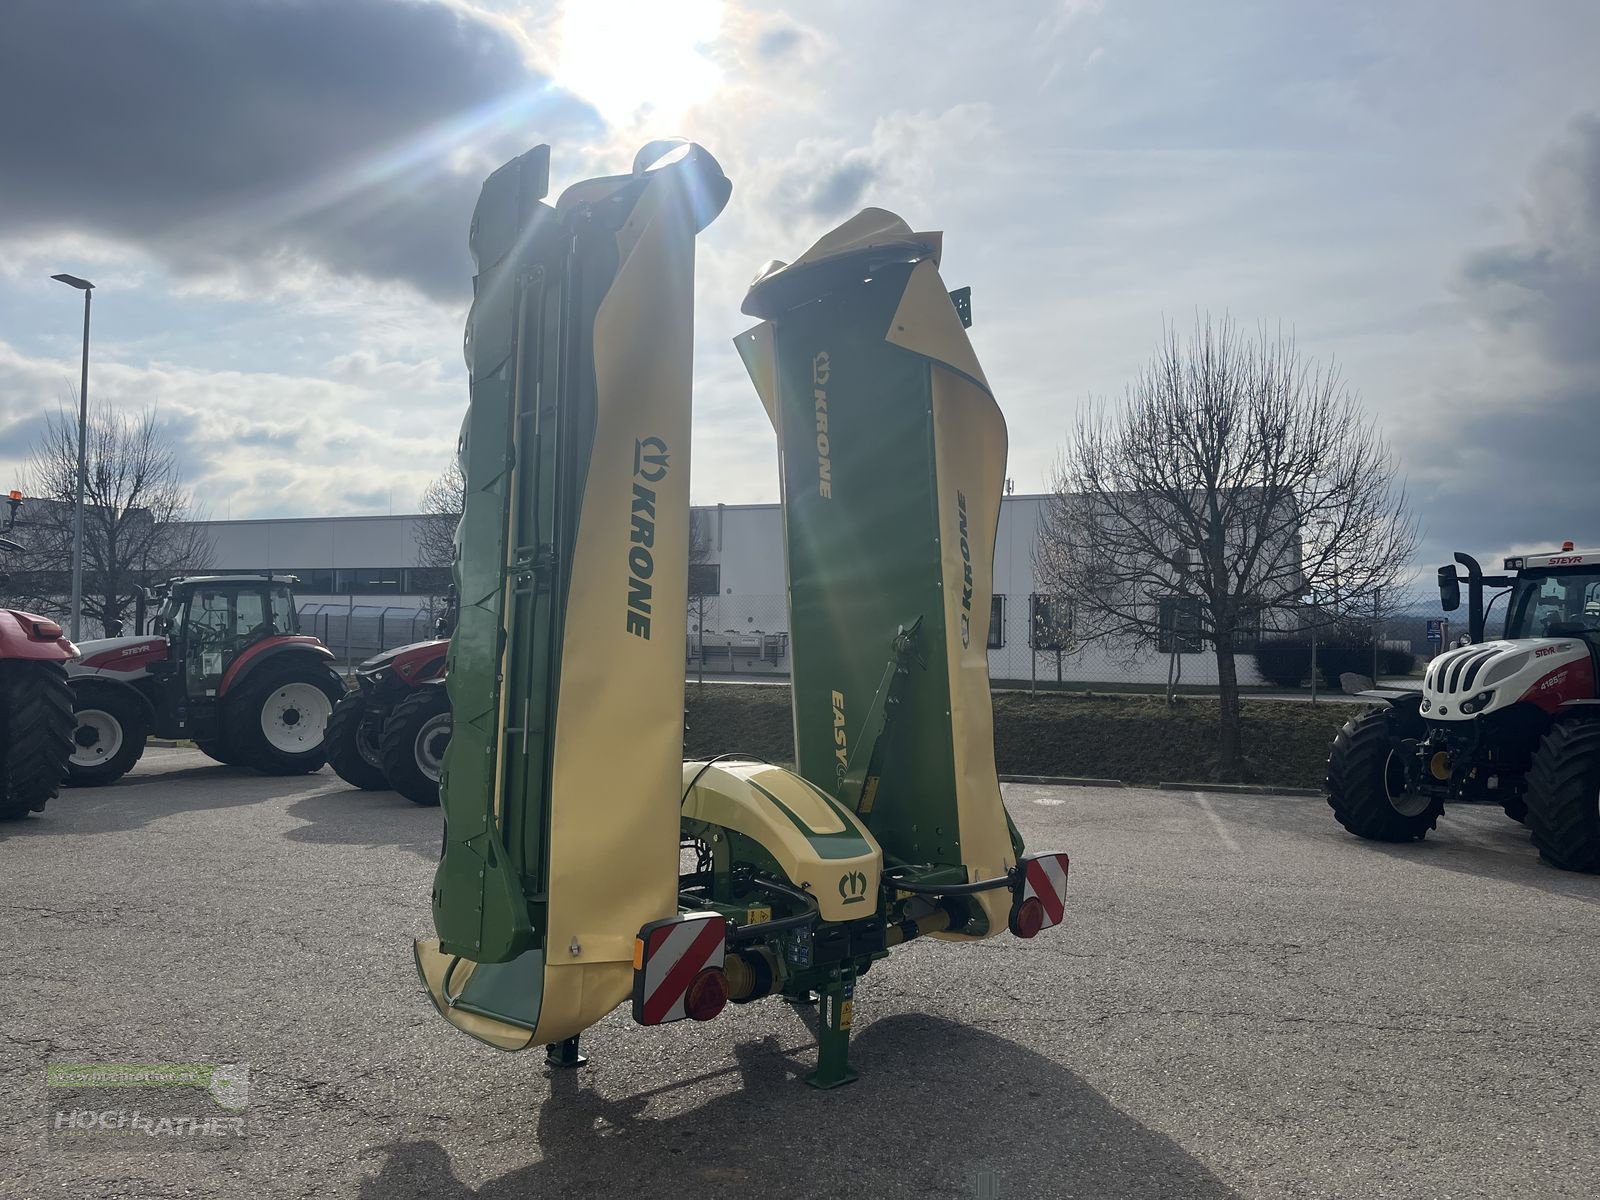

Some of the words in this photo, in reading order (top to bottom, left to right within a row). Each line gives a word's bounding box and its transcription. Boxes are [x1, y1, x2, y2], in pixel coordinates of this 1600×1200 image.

[814, 389, 832, 499] KRONE
[626, 482, 657, 641] KRONE
[956, 488, 973, 612] KRONE
[1548, 556, 1583, 565] STEYR
[121, 645, 150, 657] STEYR
[1535, 646, 1556, 658] STEYR
